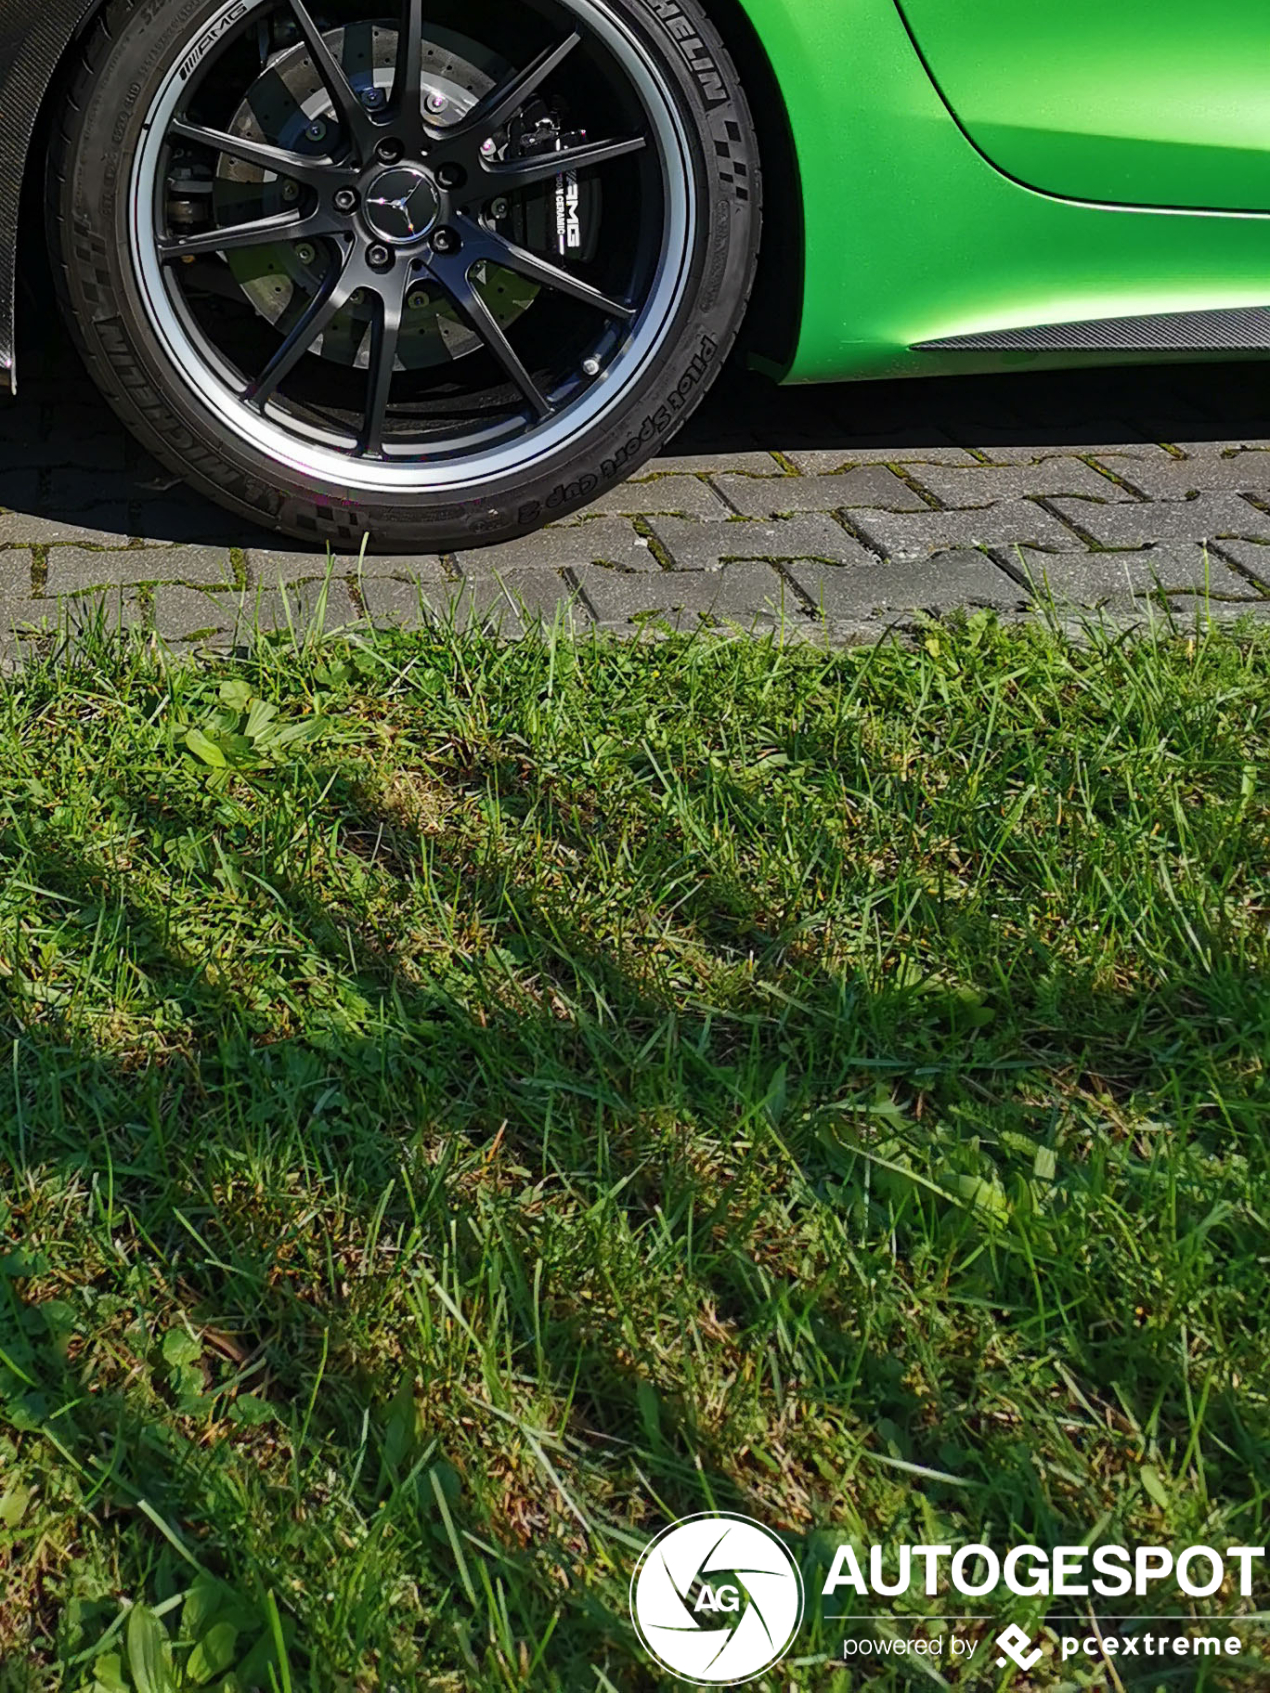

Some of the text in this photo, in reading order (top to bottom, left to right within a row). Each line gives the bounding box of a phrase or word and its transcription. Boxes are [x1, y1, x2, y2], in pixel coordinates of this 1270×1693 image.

[556, 195, 565, 235] CERAMIC
[566, 178, 581, 247] AMG
[97, 323, 240, 484] MICHELIN
[667, 334, 718, 411] Pilot
[600, 405, 672, 479] Sport
[518, 499, 541, 525] 2
[545, 473, 598, 508] Cup
